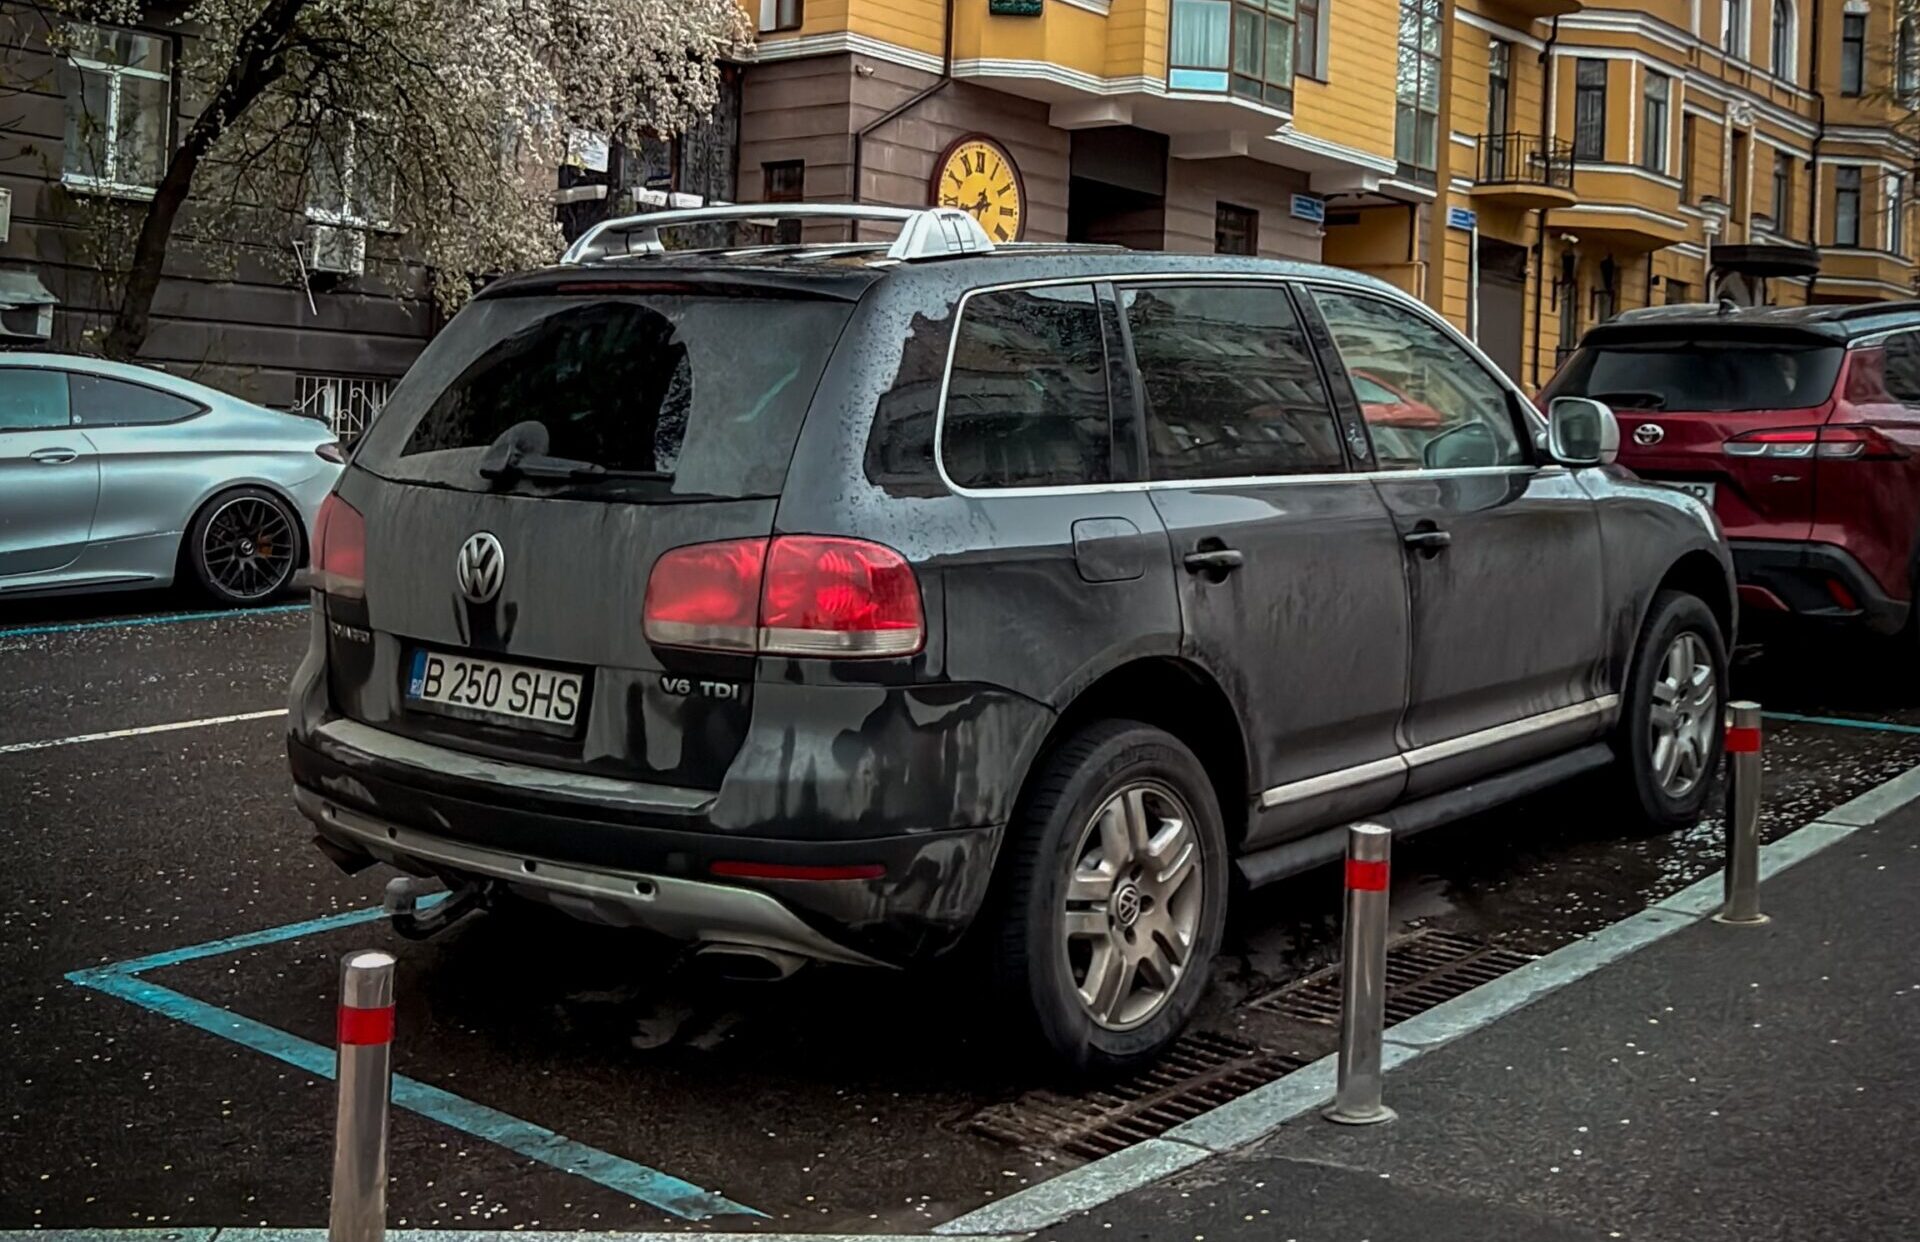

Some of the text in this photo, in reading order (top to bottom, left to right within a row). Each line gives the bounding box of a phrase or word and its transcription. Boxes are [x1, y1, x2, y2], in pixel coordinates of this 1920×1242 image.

[948, 170, 963, 190] X
[990, 162, 1000, 181] I
[423, 657, 579, 721] B 250 SHS
[661, 677, 739, 699] V6 TDI
